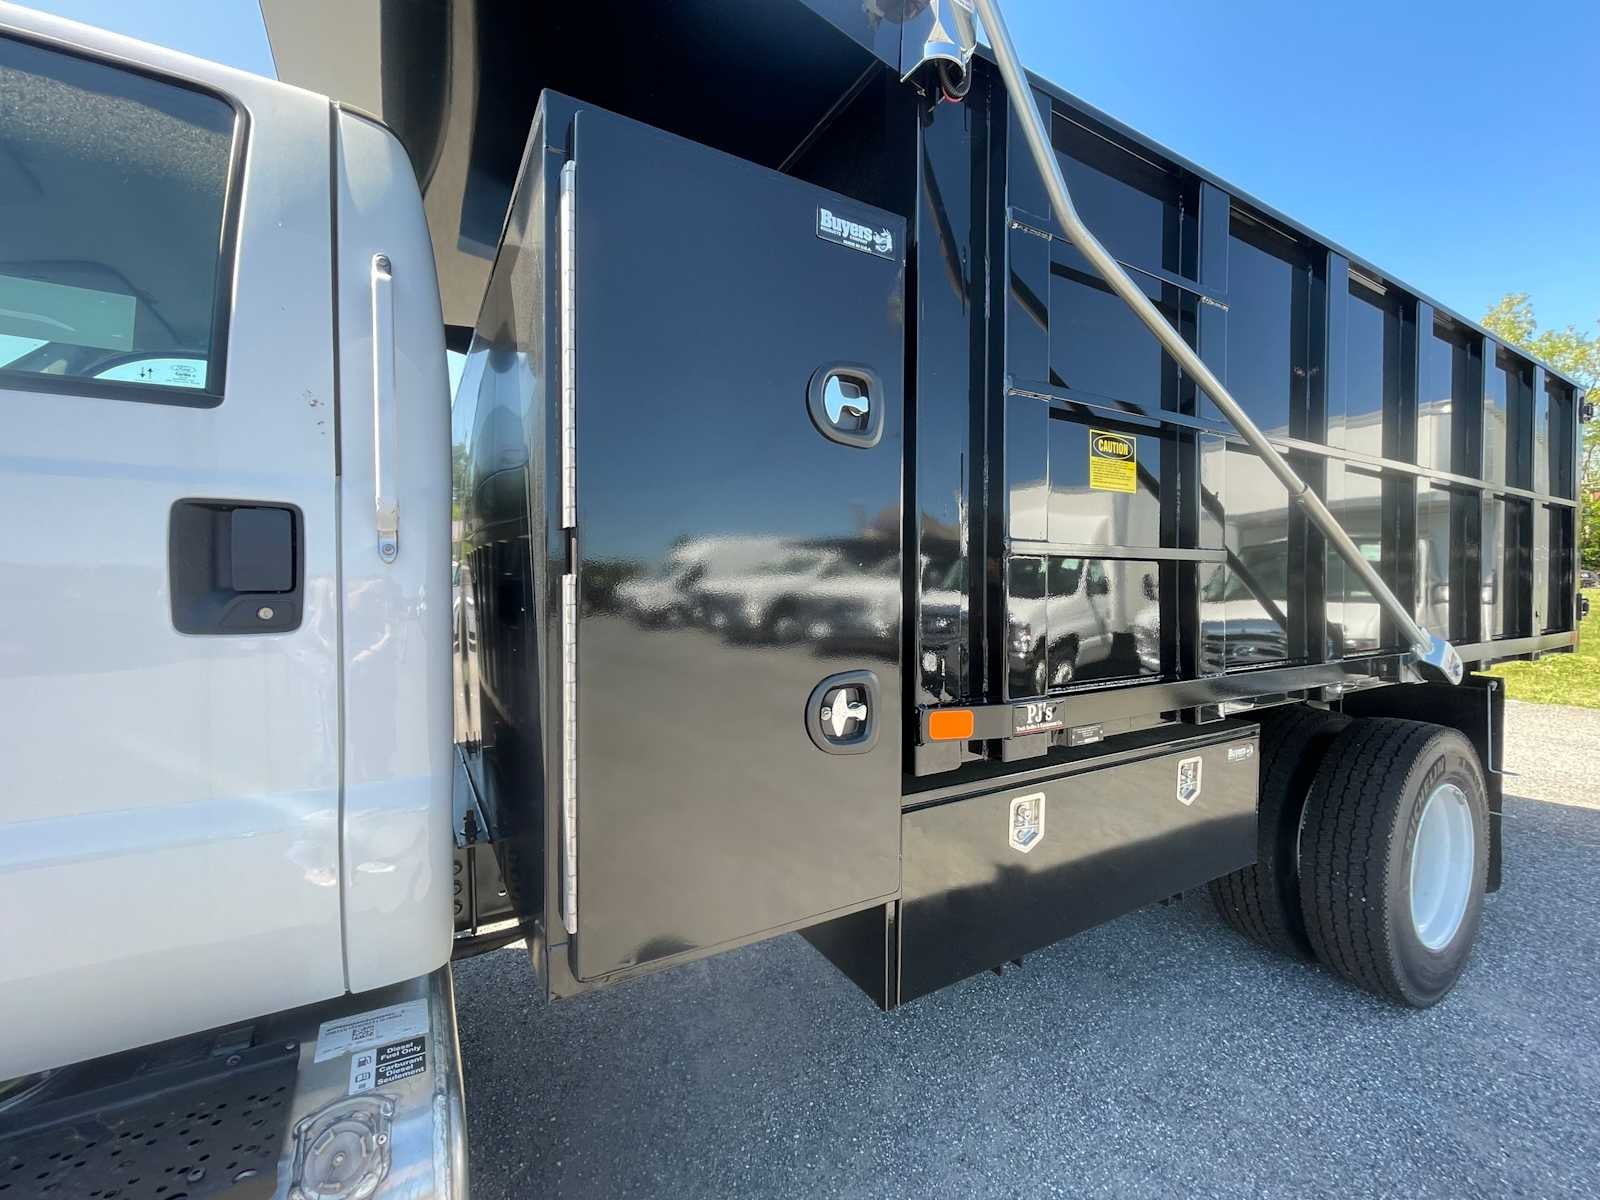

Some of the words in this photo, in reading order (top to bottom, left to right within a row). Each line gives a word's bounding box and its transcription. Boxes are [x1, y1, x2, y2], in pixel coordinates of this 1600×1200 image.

[820, 208, 873, 242] Buyers
[1098, 439, 1129, 455] CAUTION
[1026, 702, 1053, 723] PJ's
[380, 1051, 400, 1061] Fuel
[401, 1045, 422, 1055] Only
[387, 1042, 414, 1054] Diesel
[379, 1056, 423, 1073] Carburant
[386, 1064, 414, 1077] Diesel
[377, 1066, 425, 1085] Seulement
